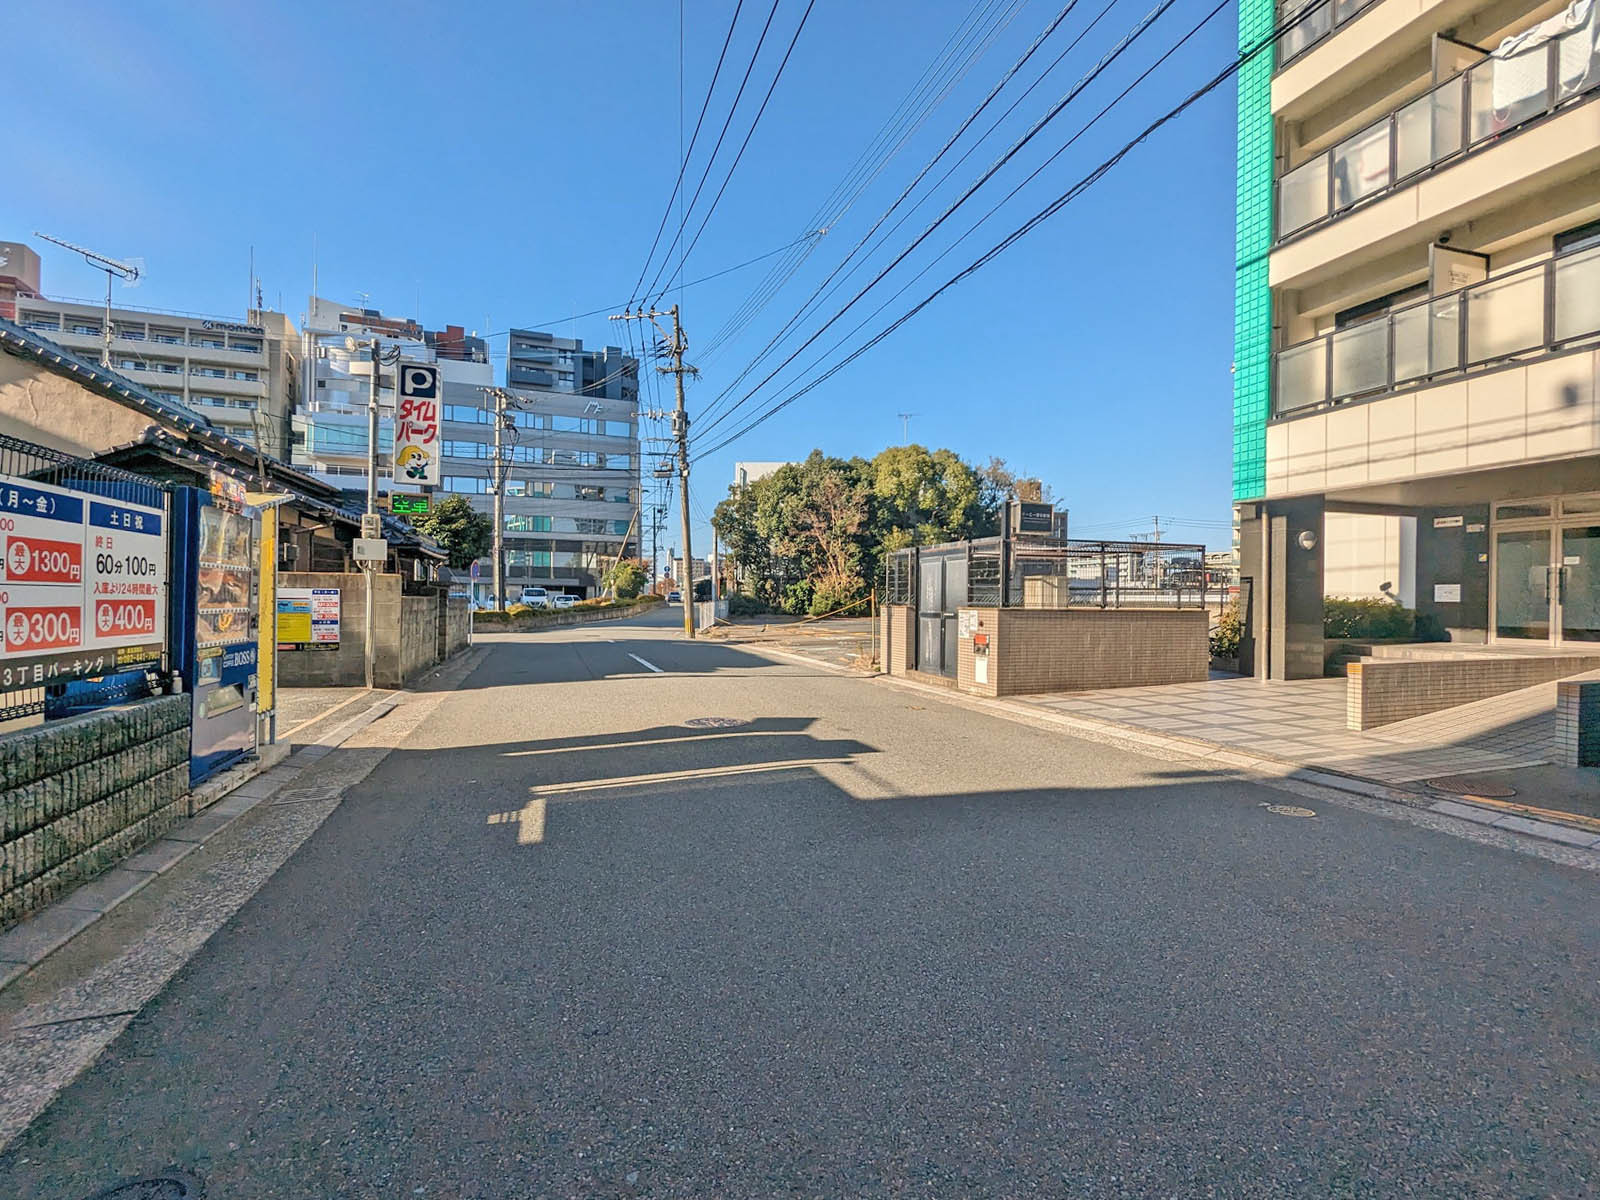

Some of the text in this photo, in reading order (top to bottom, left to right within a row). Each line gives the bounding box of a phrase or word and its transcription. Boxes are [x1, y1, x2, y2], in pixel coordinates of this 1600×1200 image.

[404, 368, 433, 395] P
[399, 399, 436, 422] タイム
[397, 421, 438, 445] パーク
[392, 494, 429, 514] 空車
[109, 511, 144, 530] 土日祝
[95, 535, 113, 550] 終日
[31, 549, 81, 580] 1300円
[30, 612, 80, 643] 300円
[114, 604, 153, 630] 400円
[234, 650, 250, 667] BOSS
